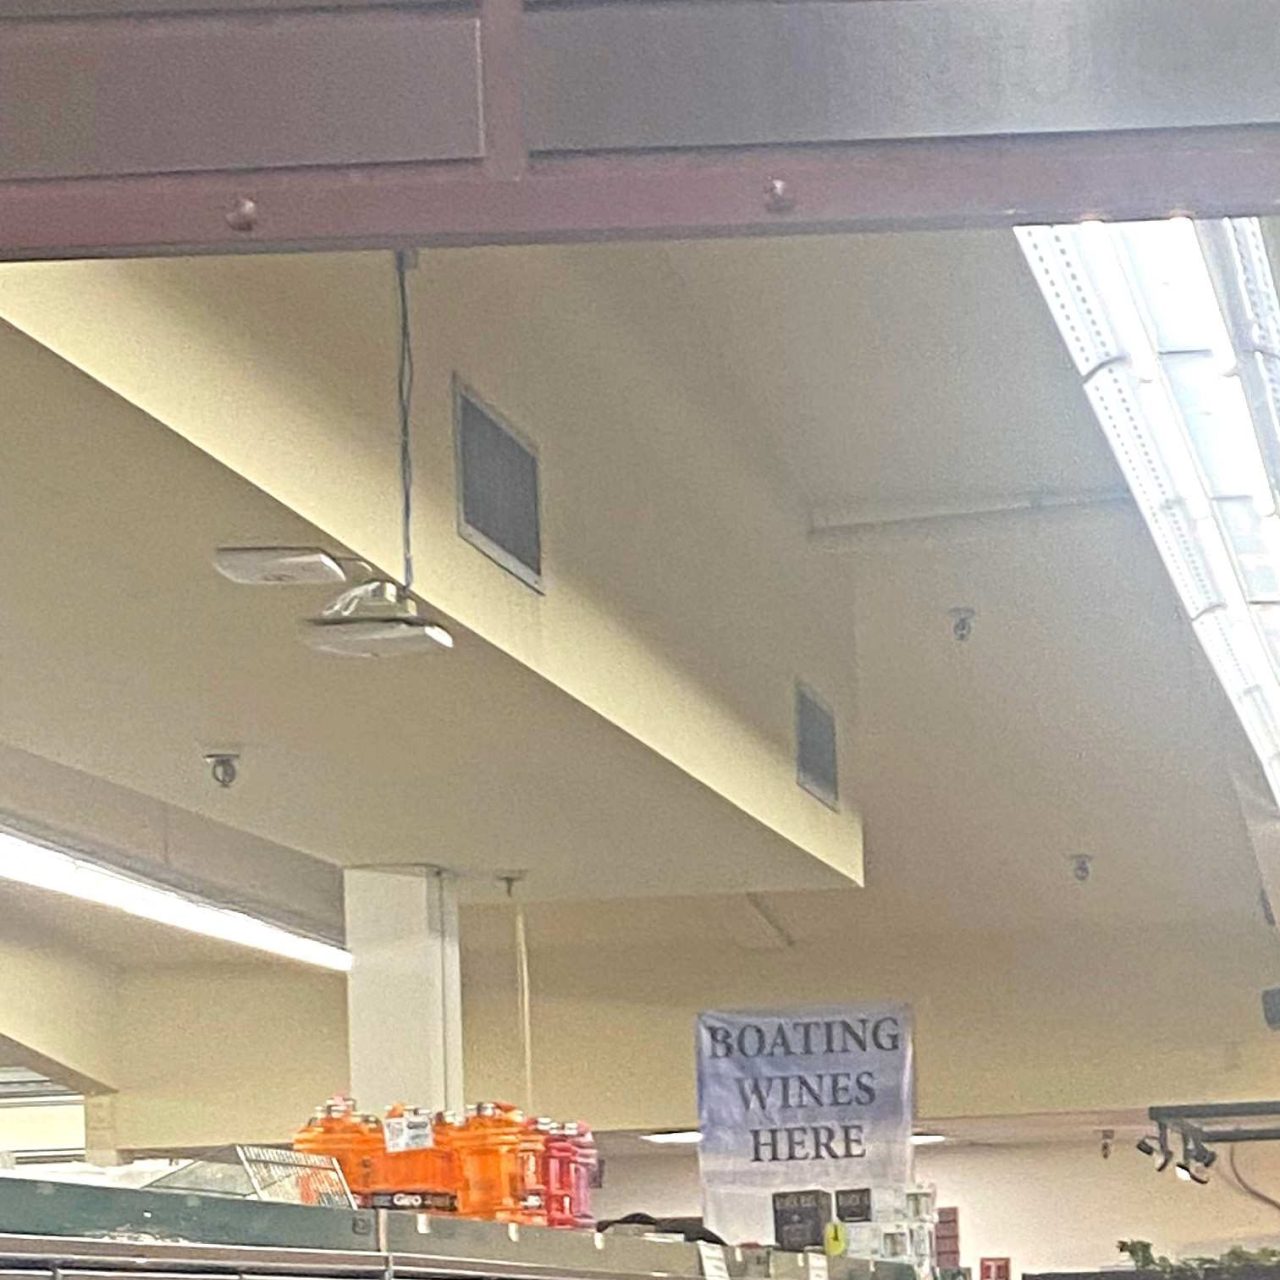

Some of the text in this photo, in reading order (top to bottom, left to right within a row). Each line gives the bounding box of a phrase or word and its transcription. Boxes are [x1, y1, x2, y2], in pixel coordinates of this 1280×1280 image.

[706, 1016, 899, 1059] BOATING
[735, 1071, 876, 1110] WINES
[750, 1124, 866, 1162] HERE
